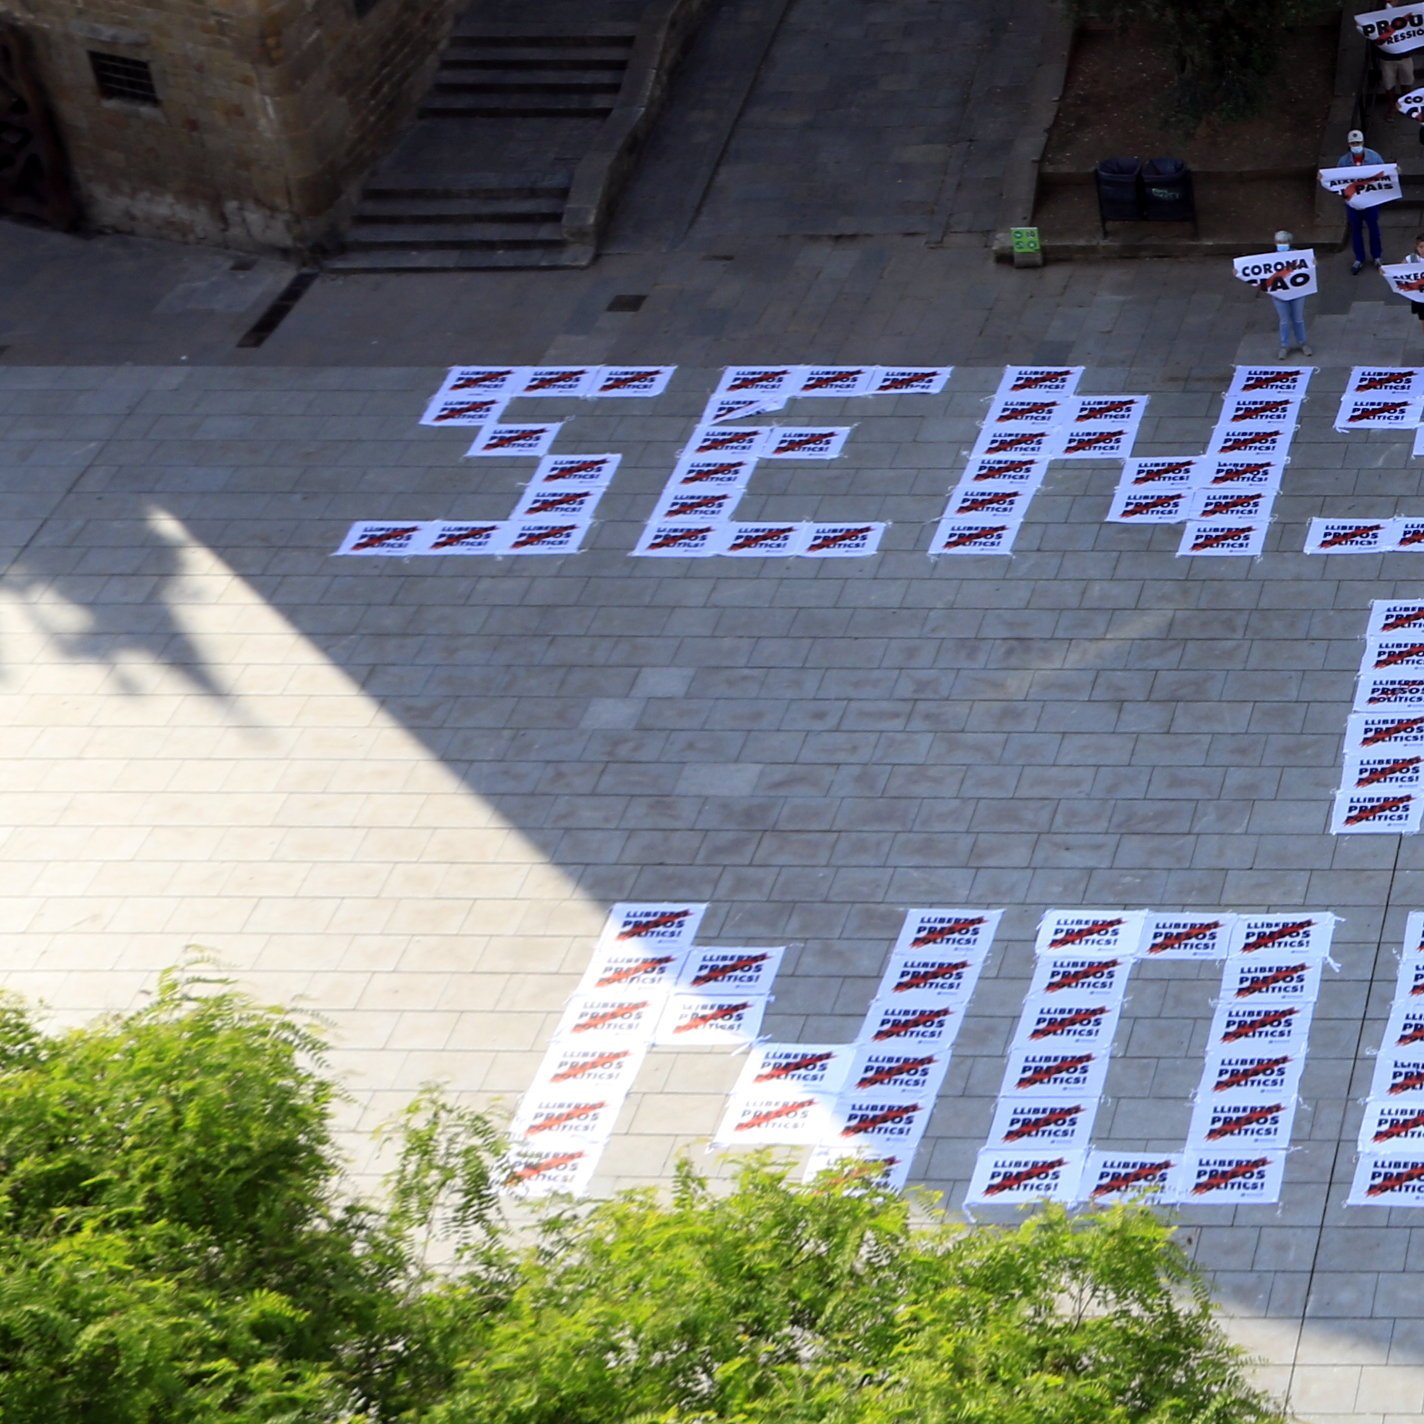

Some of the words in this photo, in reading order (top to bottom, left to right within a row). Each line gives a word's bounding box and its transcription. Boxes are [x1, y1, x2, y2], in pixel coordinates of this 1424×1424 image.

[1363, 14, 1423, 36] PROU
[1356, 184, 1393, 195] PAÍS
[1242, 259, 1309, 277] CORONA
